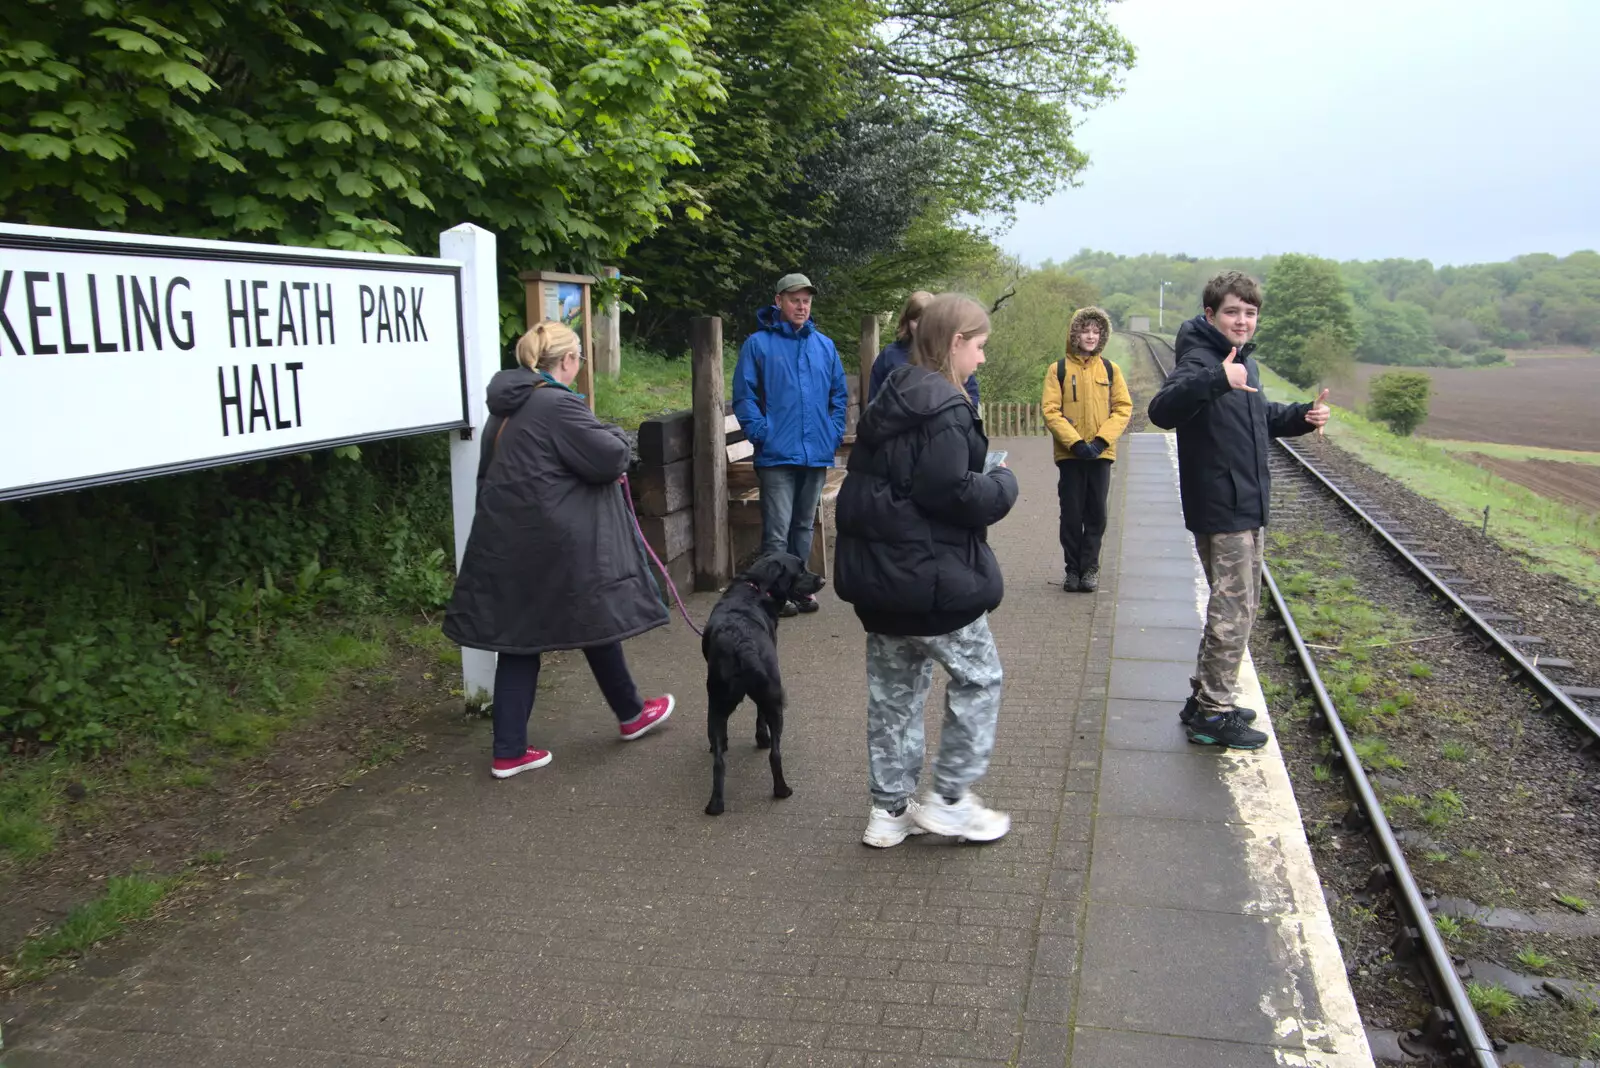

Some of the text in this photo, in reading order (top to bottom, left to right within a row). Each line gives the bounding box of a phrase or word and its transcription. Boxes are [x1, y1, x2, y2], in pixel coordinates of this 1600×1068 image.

[0, 270, 428, 356] KELLING HEATH PARK
[218, 362, 303, 437] HALT
